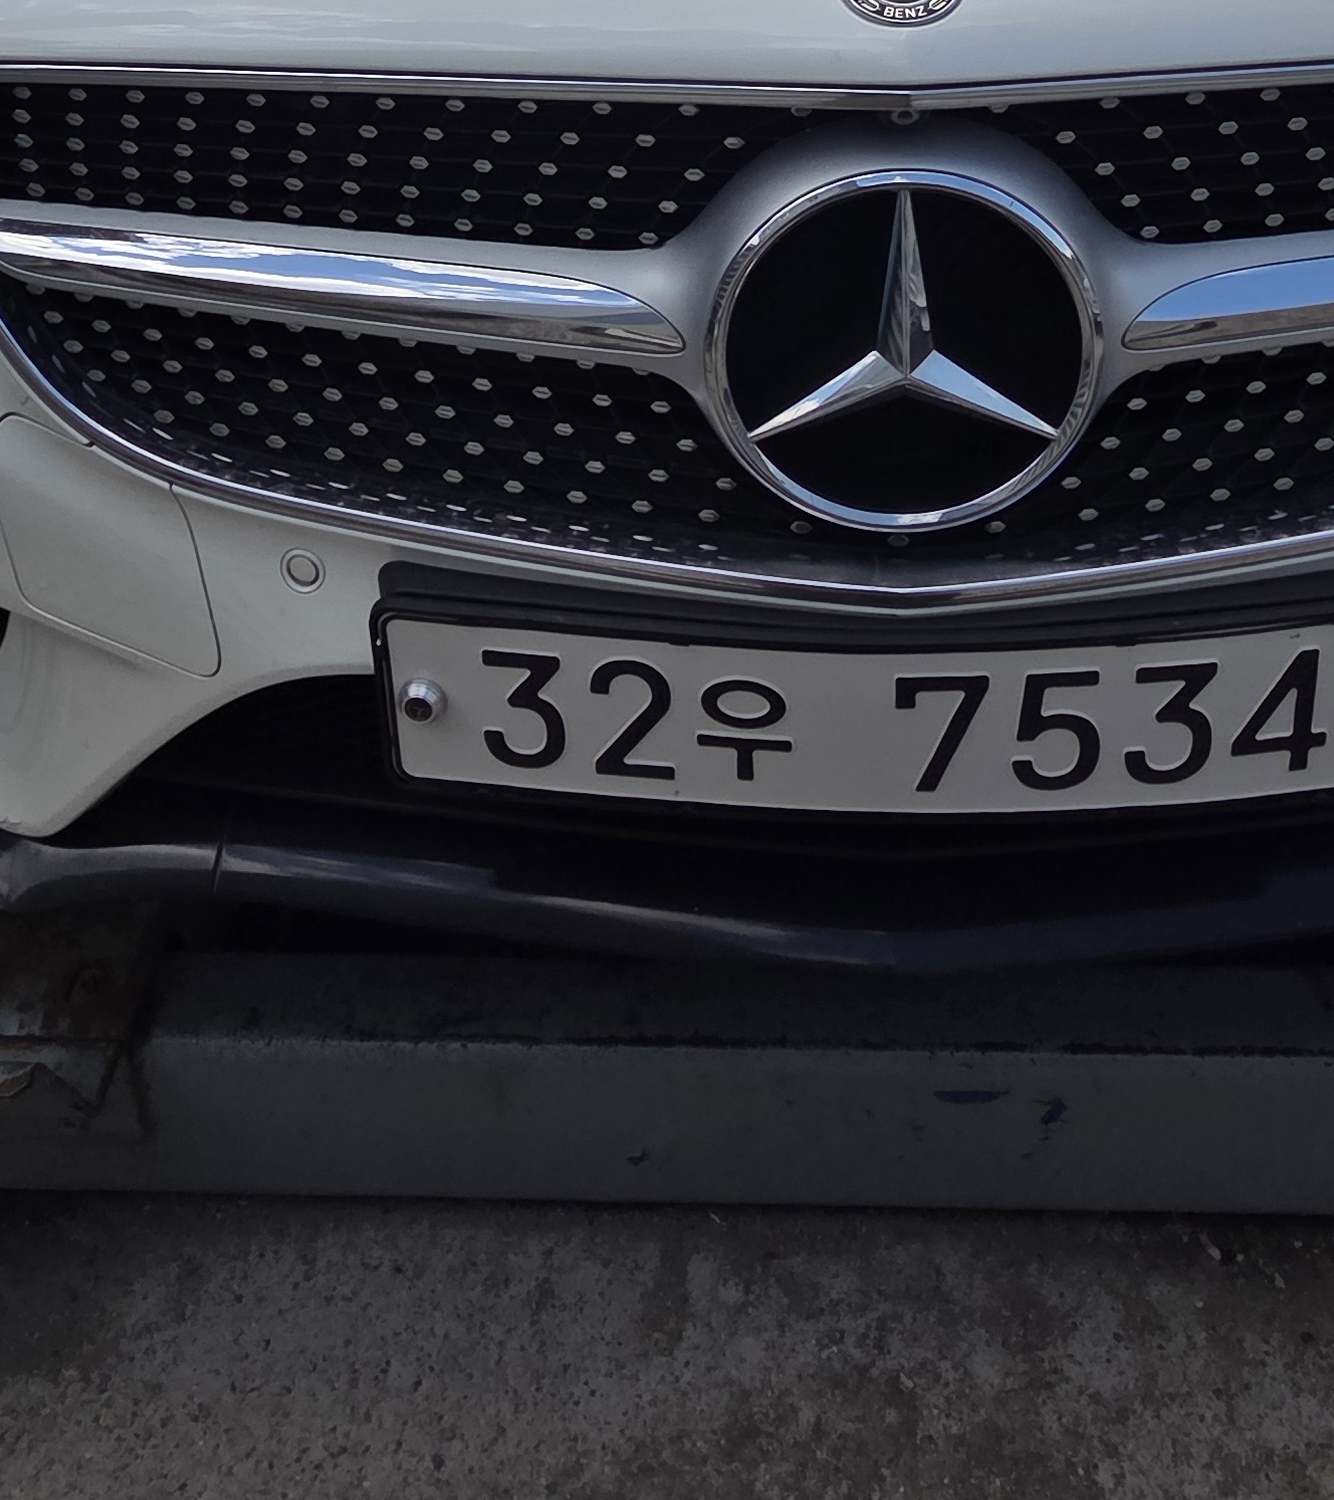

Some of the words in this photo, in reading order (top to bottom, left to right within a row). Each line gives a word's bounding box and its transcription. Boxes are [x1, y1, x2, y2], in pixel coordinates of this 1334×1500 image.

[883, 6, 928, 19] BENZ
[481, 649, 793, 781] 32우
[894, 648, 1328, 792] 7534
